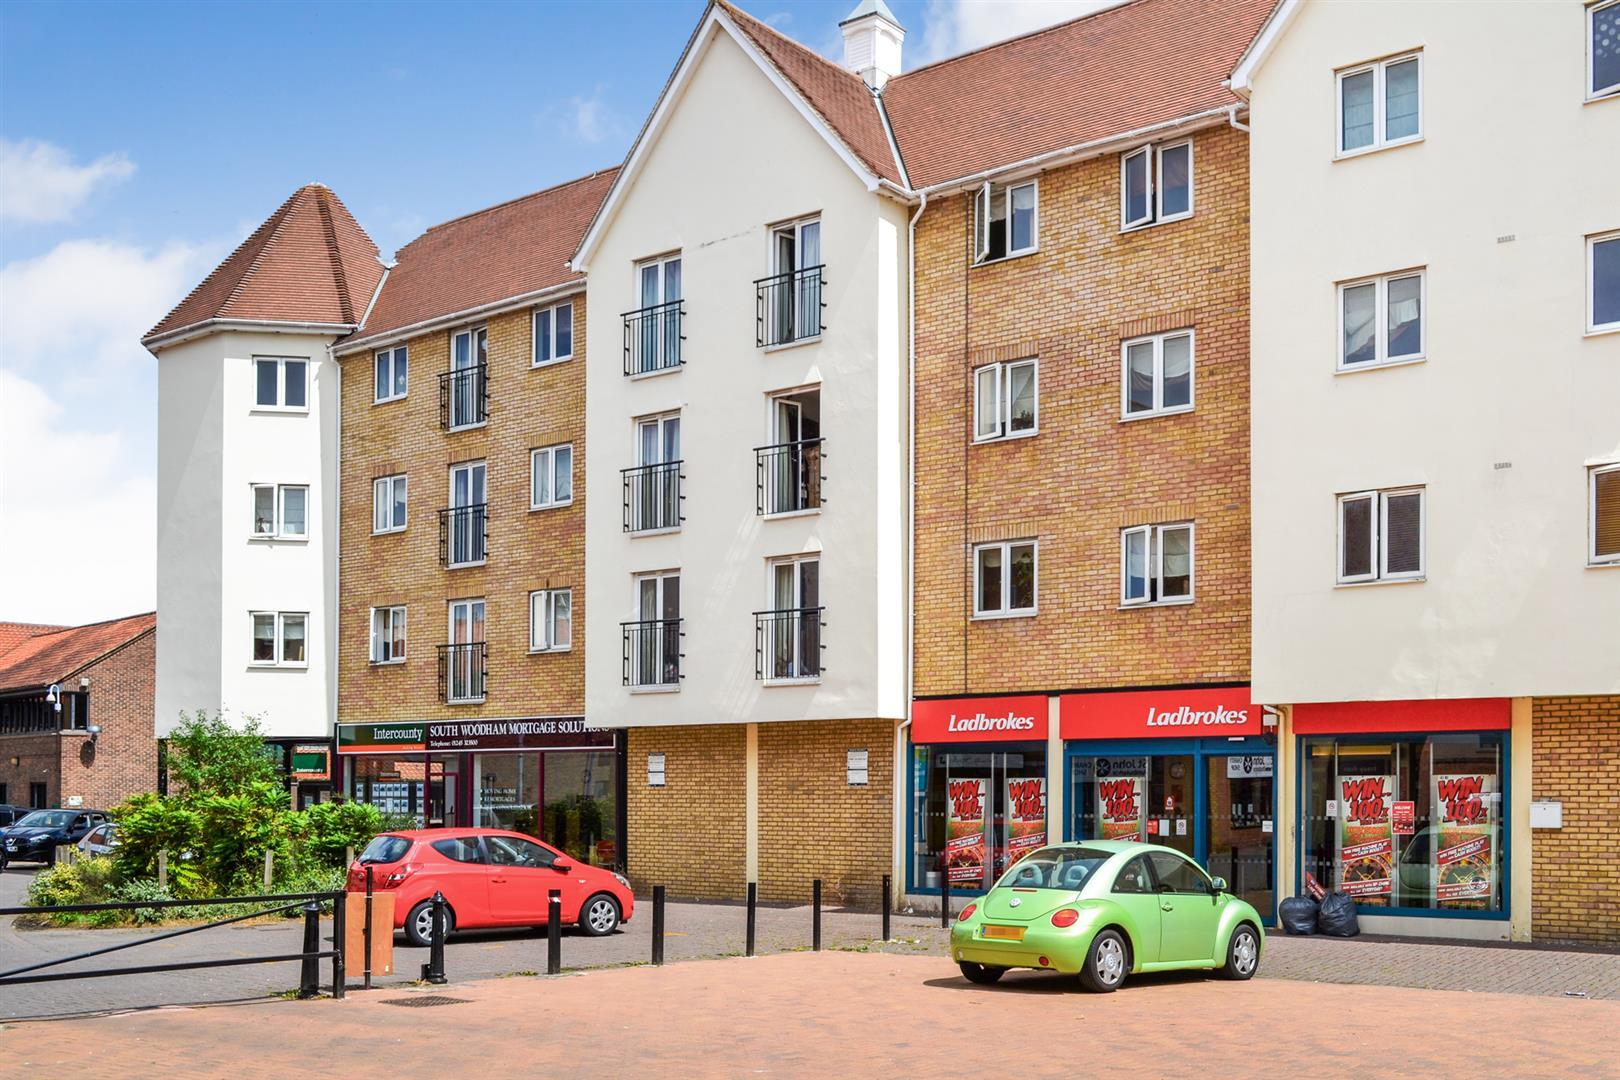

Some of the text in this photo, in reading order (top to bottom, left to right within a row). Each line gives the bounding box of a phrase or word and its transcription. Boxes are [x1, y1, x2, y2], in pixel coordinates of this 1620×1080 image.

[948, 712, 1035, 732] Ladbrokes
[1146, 704, 1248, 726] Ladbrokes
[373, 727, 423, 741] Intercounty
[429, 724, 459, 737] SOUTH
[460, 722, 507, 737] WOODHAM
[508, 721, 557, 735] MORTGAGE
[948, 779, 981, 801] WIN
[1008, 779, 1042, 801] WIN
[1100, 778, 1135, 801] WIN
[1342, 777, 1385, 802] WIN
[1438, 775, 1484, 802] WIN
